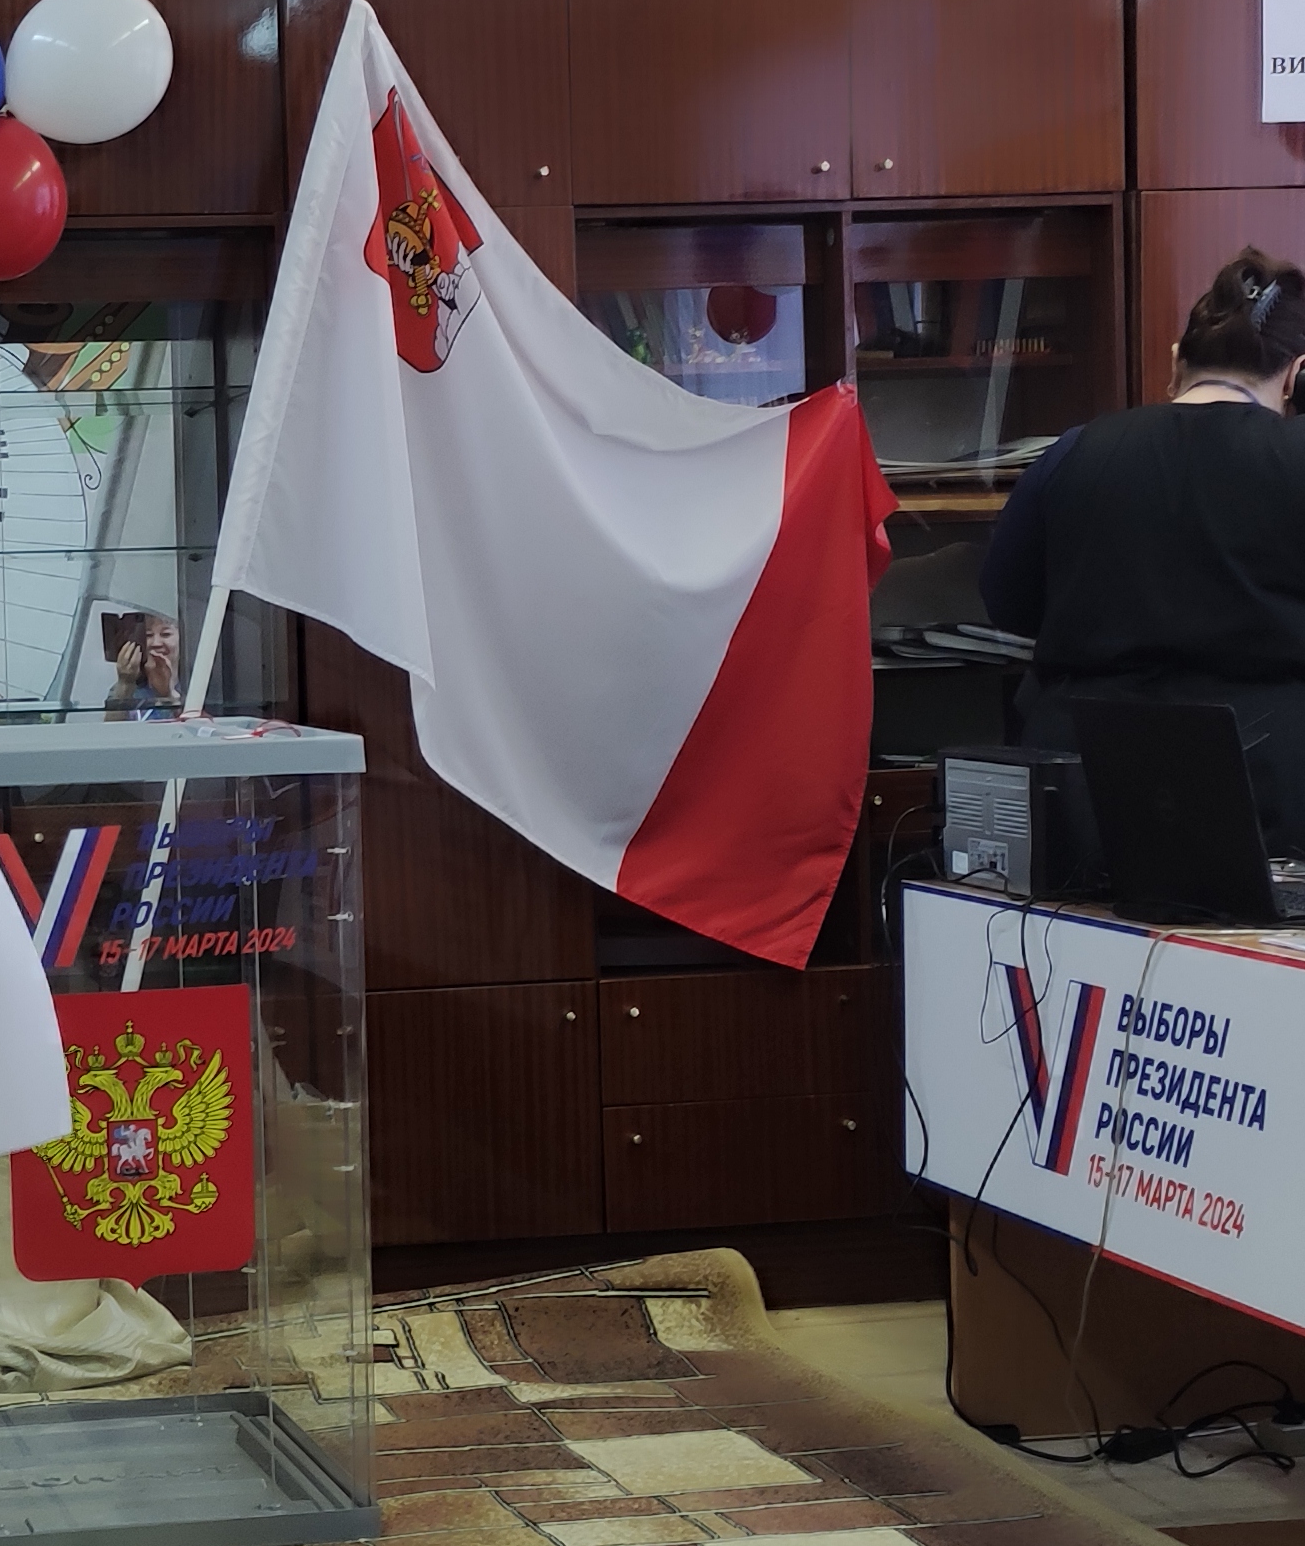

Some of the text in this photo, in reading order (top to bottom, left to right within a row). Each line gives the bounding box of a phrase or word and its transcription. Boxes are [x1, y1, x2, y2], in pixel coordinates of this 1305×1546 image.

[123, 850, 317, 890] ПРЕЗИДЕНТА
[109, 894, 237, 932] РОССИИ
[163, 930, 239, 962] МАРТА
[243, 925, 297, 955] 2024
[1117, 994, 1230, 1057] ВЫБОРЫ
[1106, 1048, 1267, 1131] ПРЕЗИДЕНТА
[1095, 1102, 1195, 1168] РОССИИ
[1135, 1170, 1196, 1222] МАРТА
[1198, 1192, 1245, 1239] 2024
